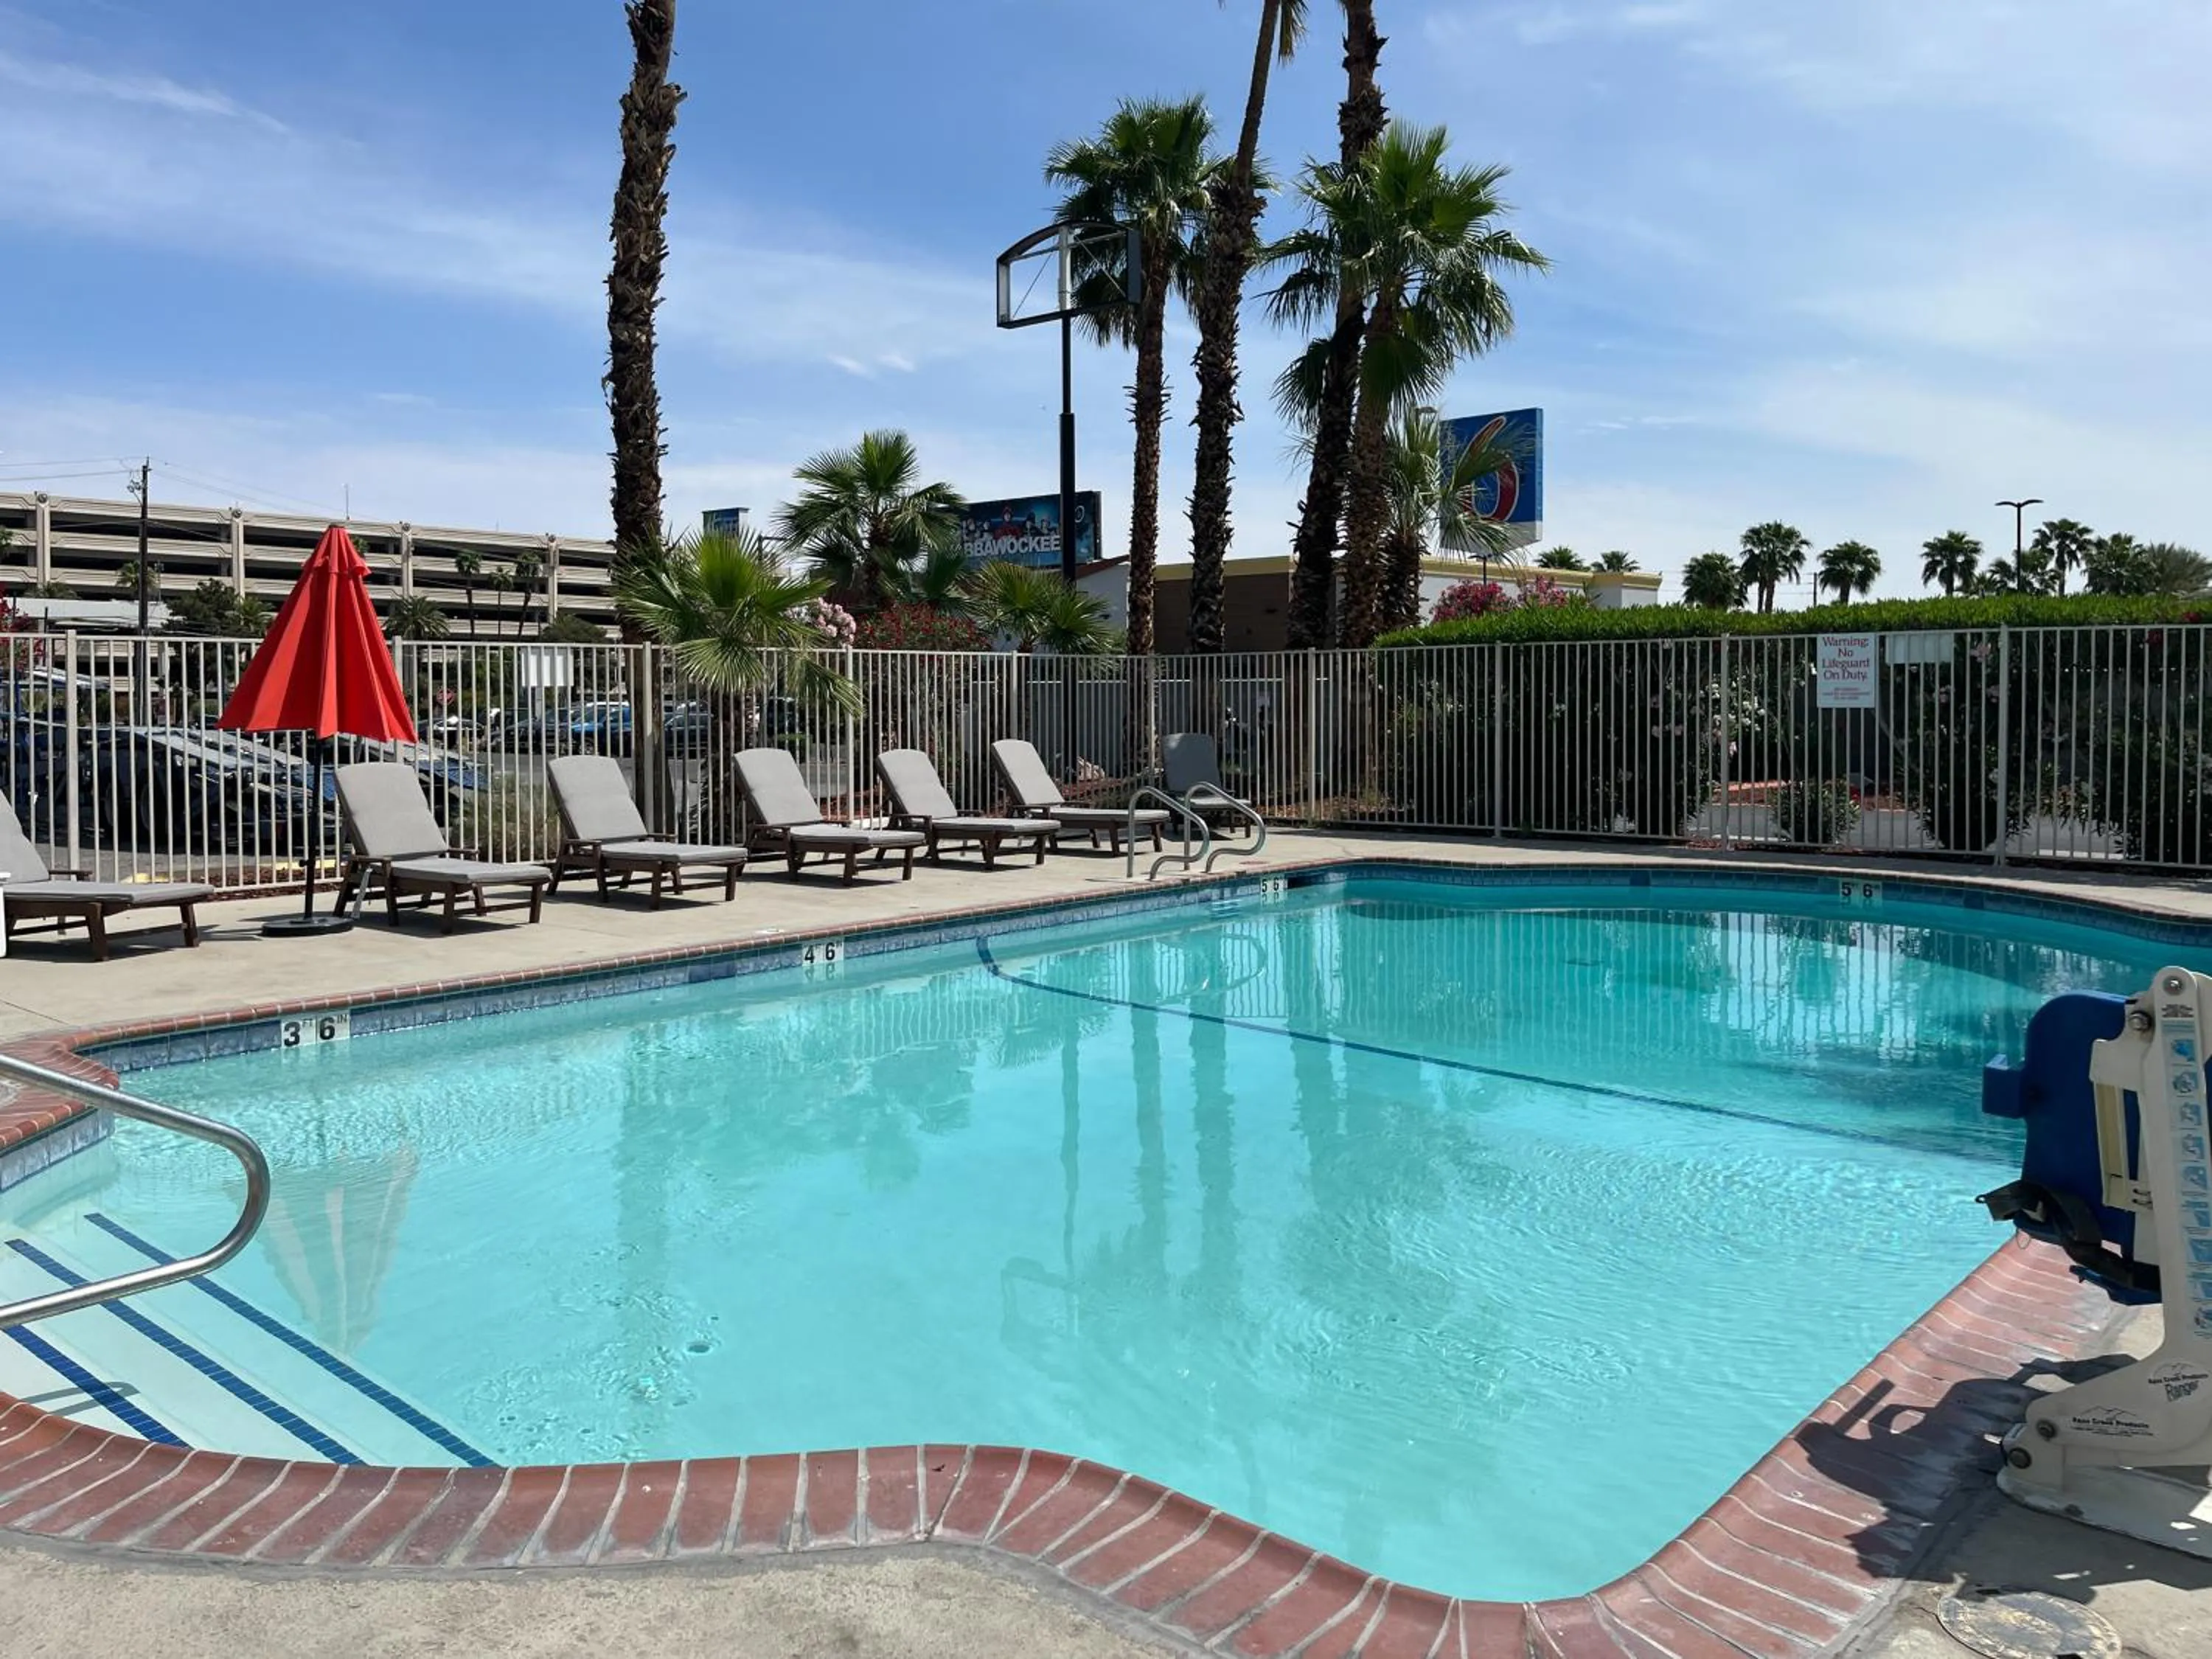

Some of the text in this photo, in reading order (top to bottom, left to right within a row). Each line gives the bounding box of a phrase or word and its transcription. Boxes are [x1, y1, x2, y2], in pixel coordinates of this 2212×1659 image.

[1454, 415, 1519, 522] 6
[963, 535, 1061, 558] BBAWOCKEE
[1838, 647, 1853, 658] No
[1822, 658, 1869, 669] Lifeguard
[1823, 669, 1840, 680] On
[1262, 877, 1279, 893] 5 6
[1841, 882, 1873, 898] 5 6
[804, 945, 815, 964] 4
[826, 942, 835, 961] 6
[284, 1021, 300, 1047] 3
[319, 1017, 335, 1040] 6
